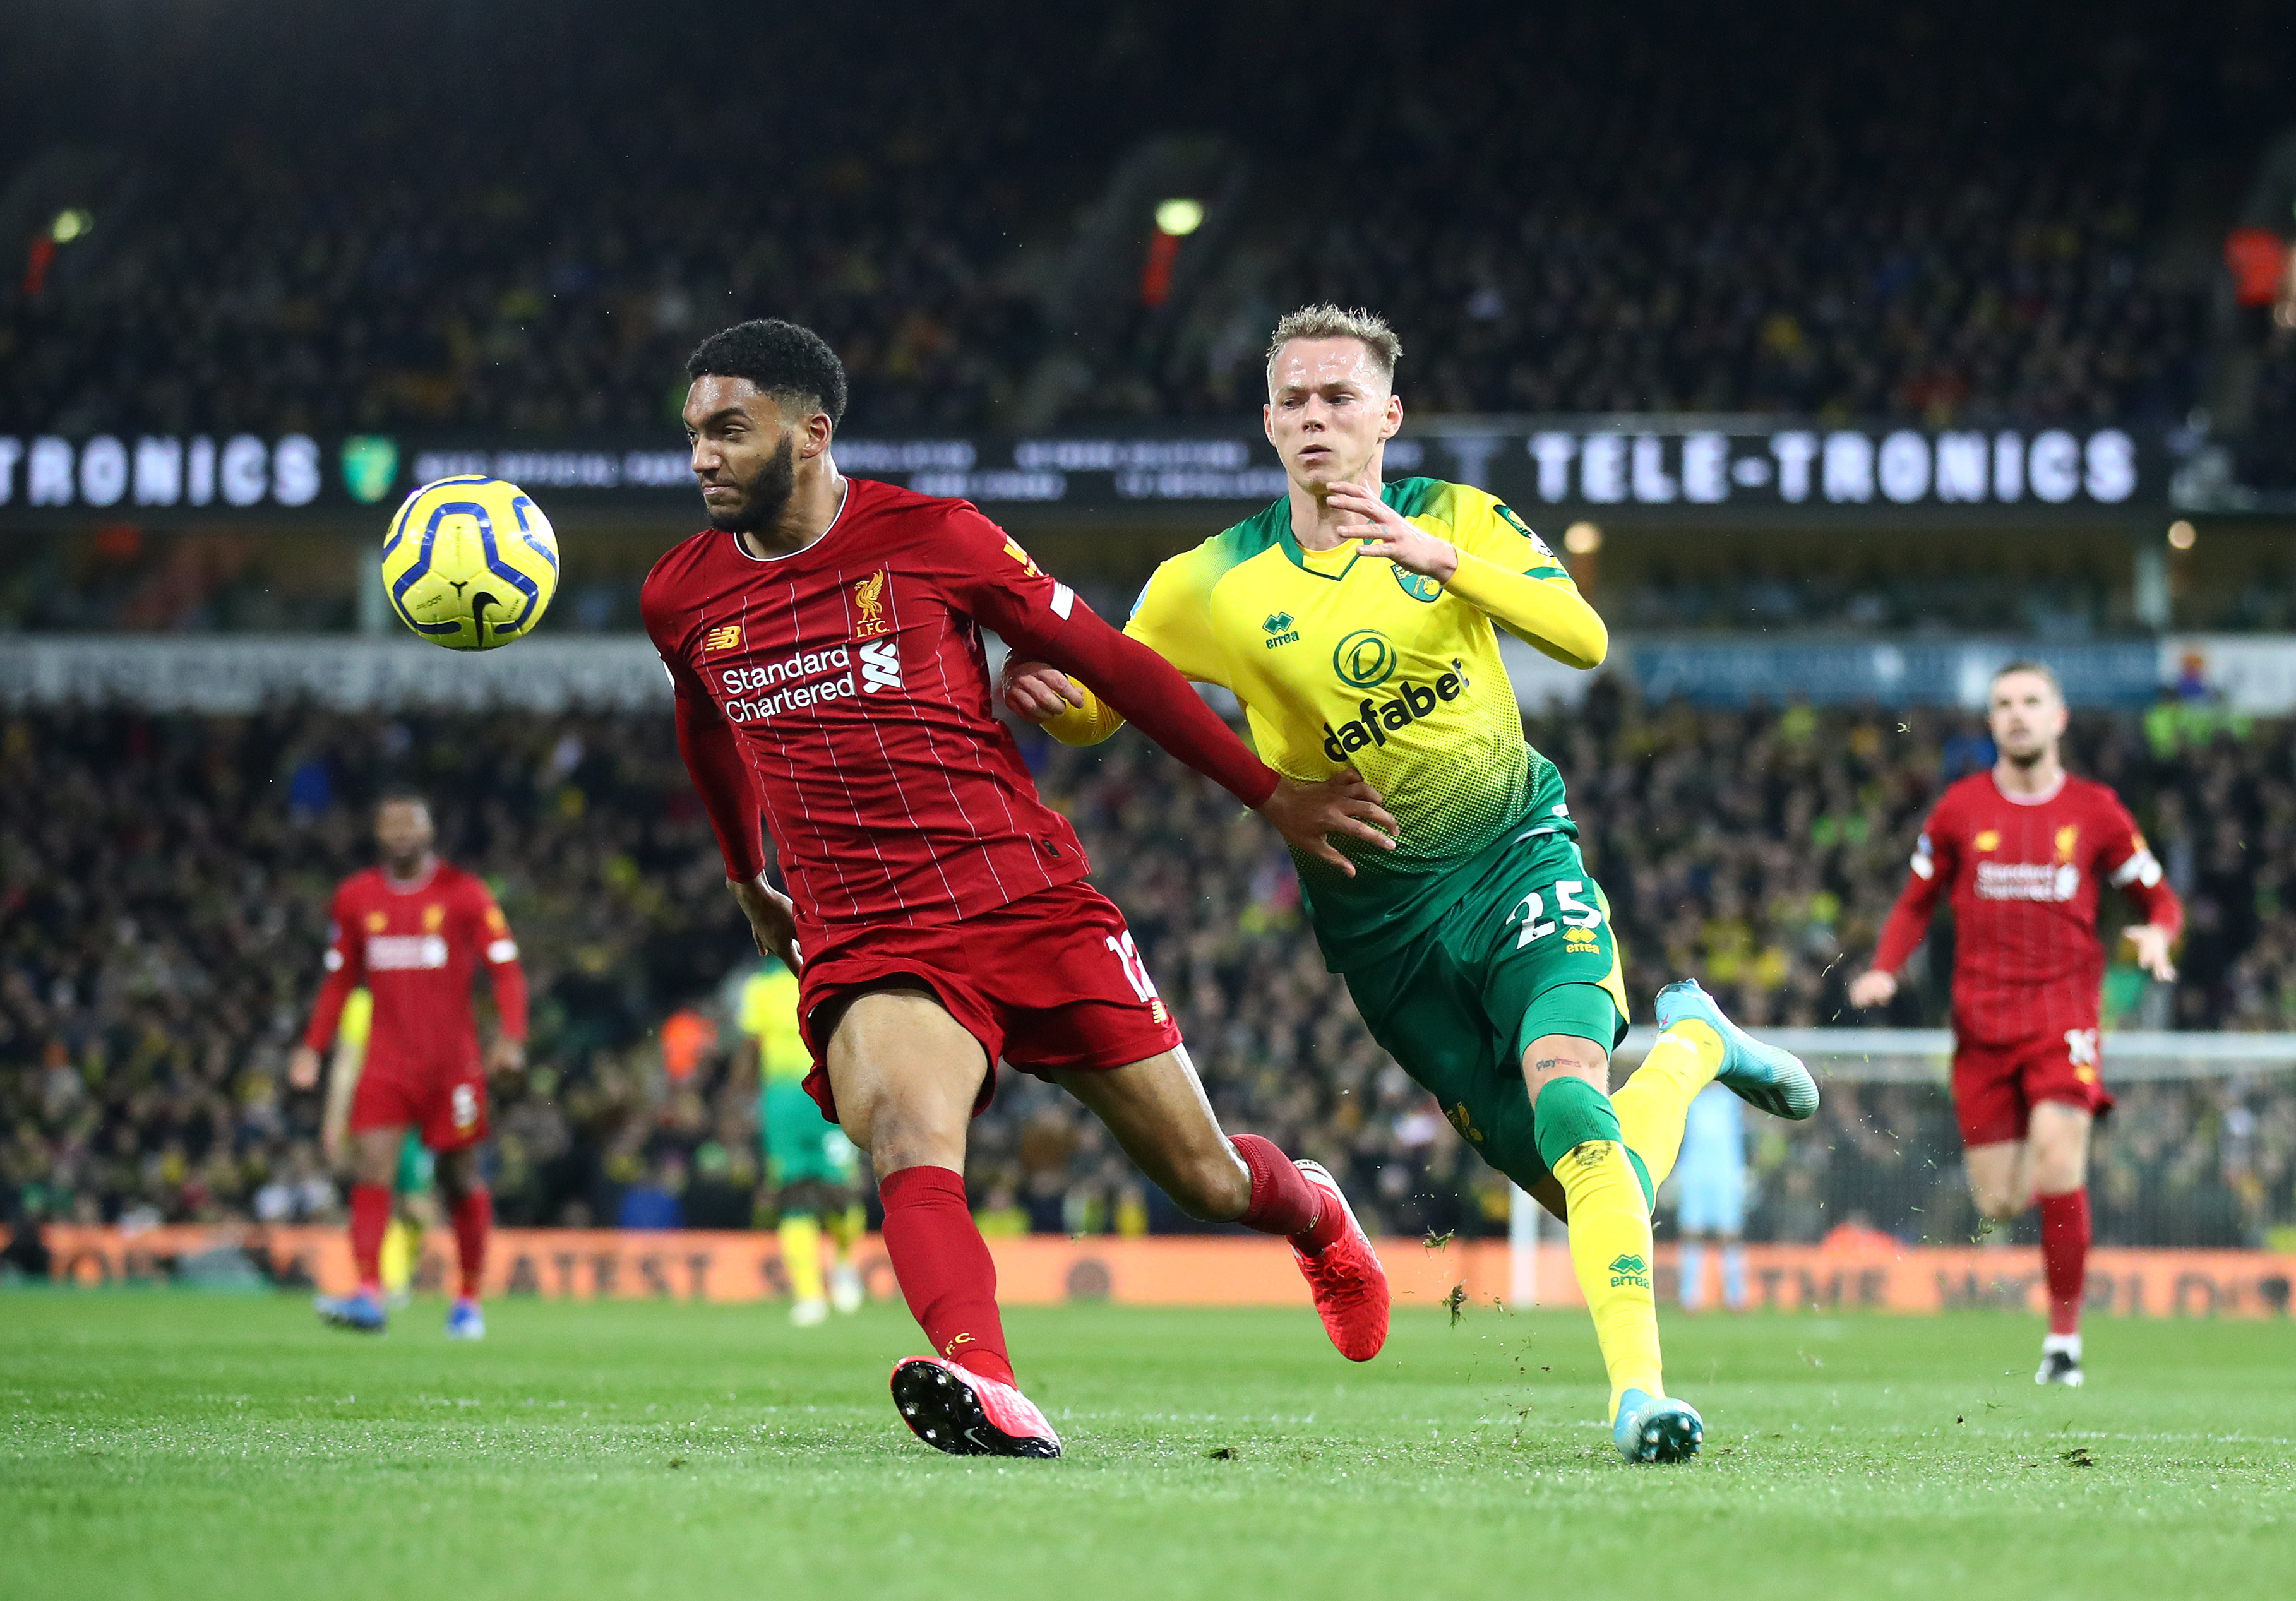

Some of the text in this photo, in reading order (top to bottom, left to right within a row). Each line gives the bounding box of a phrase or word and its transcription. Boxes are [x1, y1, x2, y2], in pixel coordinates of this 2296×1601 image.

[1528, 429, 2137, 504] TELE-TRONICS
[1266, 631, 1300, 649] errea
[722, 643, 851, 694] Standard
[726, 672, 856, 723] Chartered
[1323, 657, 1470, 763] dafabet
[1505, 880, 1603, 949] 25
[1105, 929, 1159, 1003] 12
[1565, 943, 1601, 955] errea
[1610, 1275, 1649, 1289] errea
